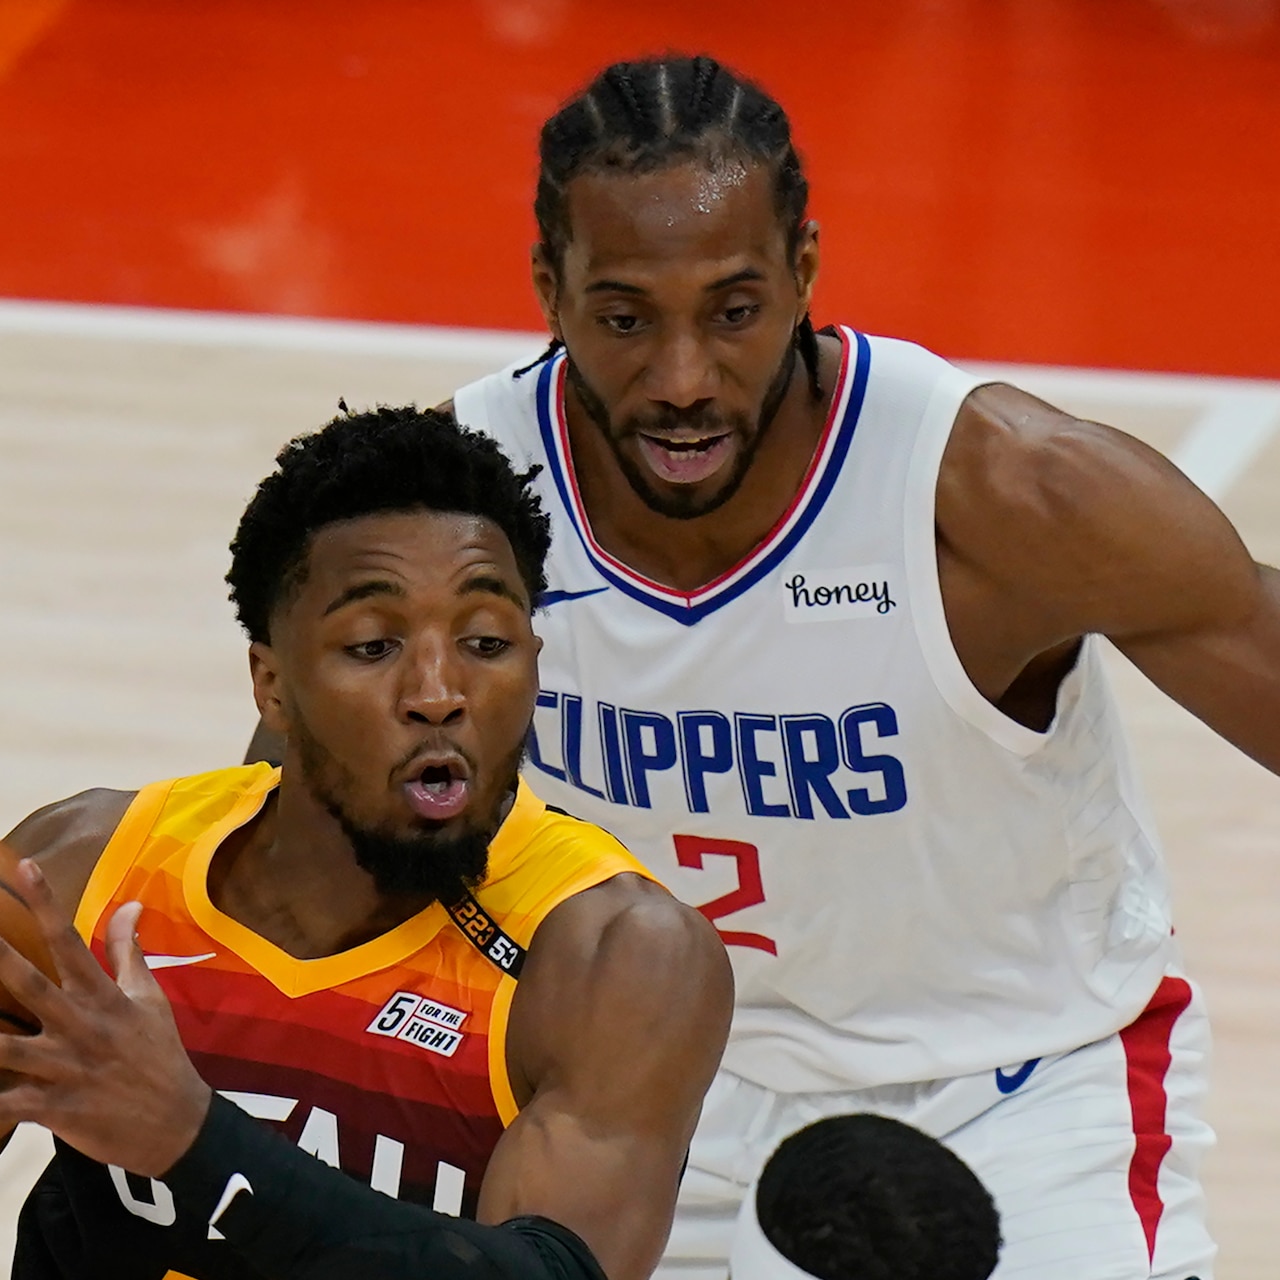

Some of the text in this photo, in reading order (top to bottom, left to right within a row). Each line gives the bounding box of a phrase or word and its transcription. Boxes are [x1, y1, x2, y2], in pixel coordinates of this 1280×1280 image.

[785, 574, 897, 614] honey
[527, 690, 908, 821] CLIPPERS
[672, 833, 778, 957] 2
[488, 935, 519, 969] 53
[377, 996, 415, 1031] 5
[420, 1003, 461, 1026] FOR THE
[405, 1021, 458, 1051] FIGHT
